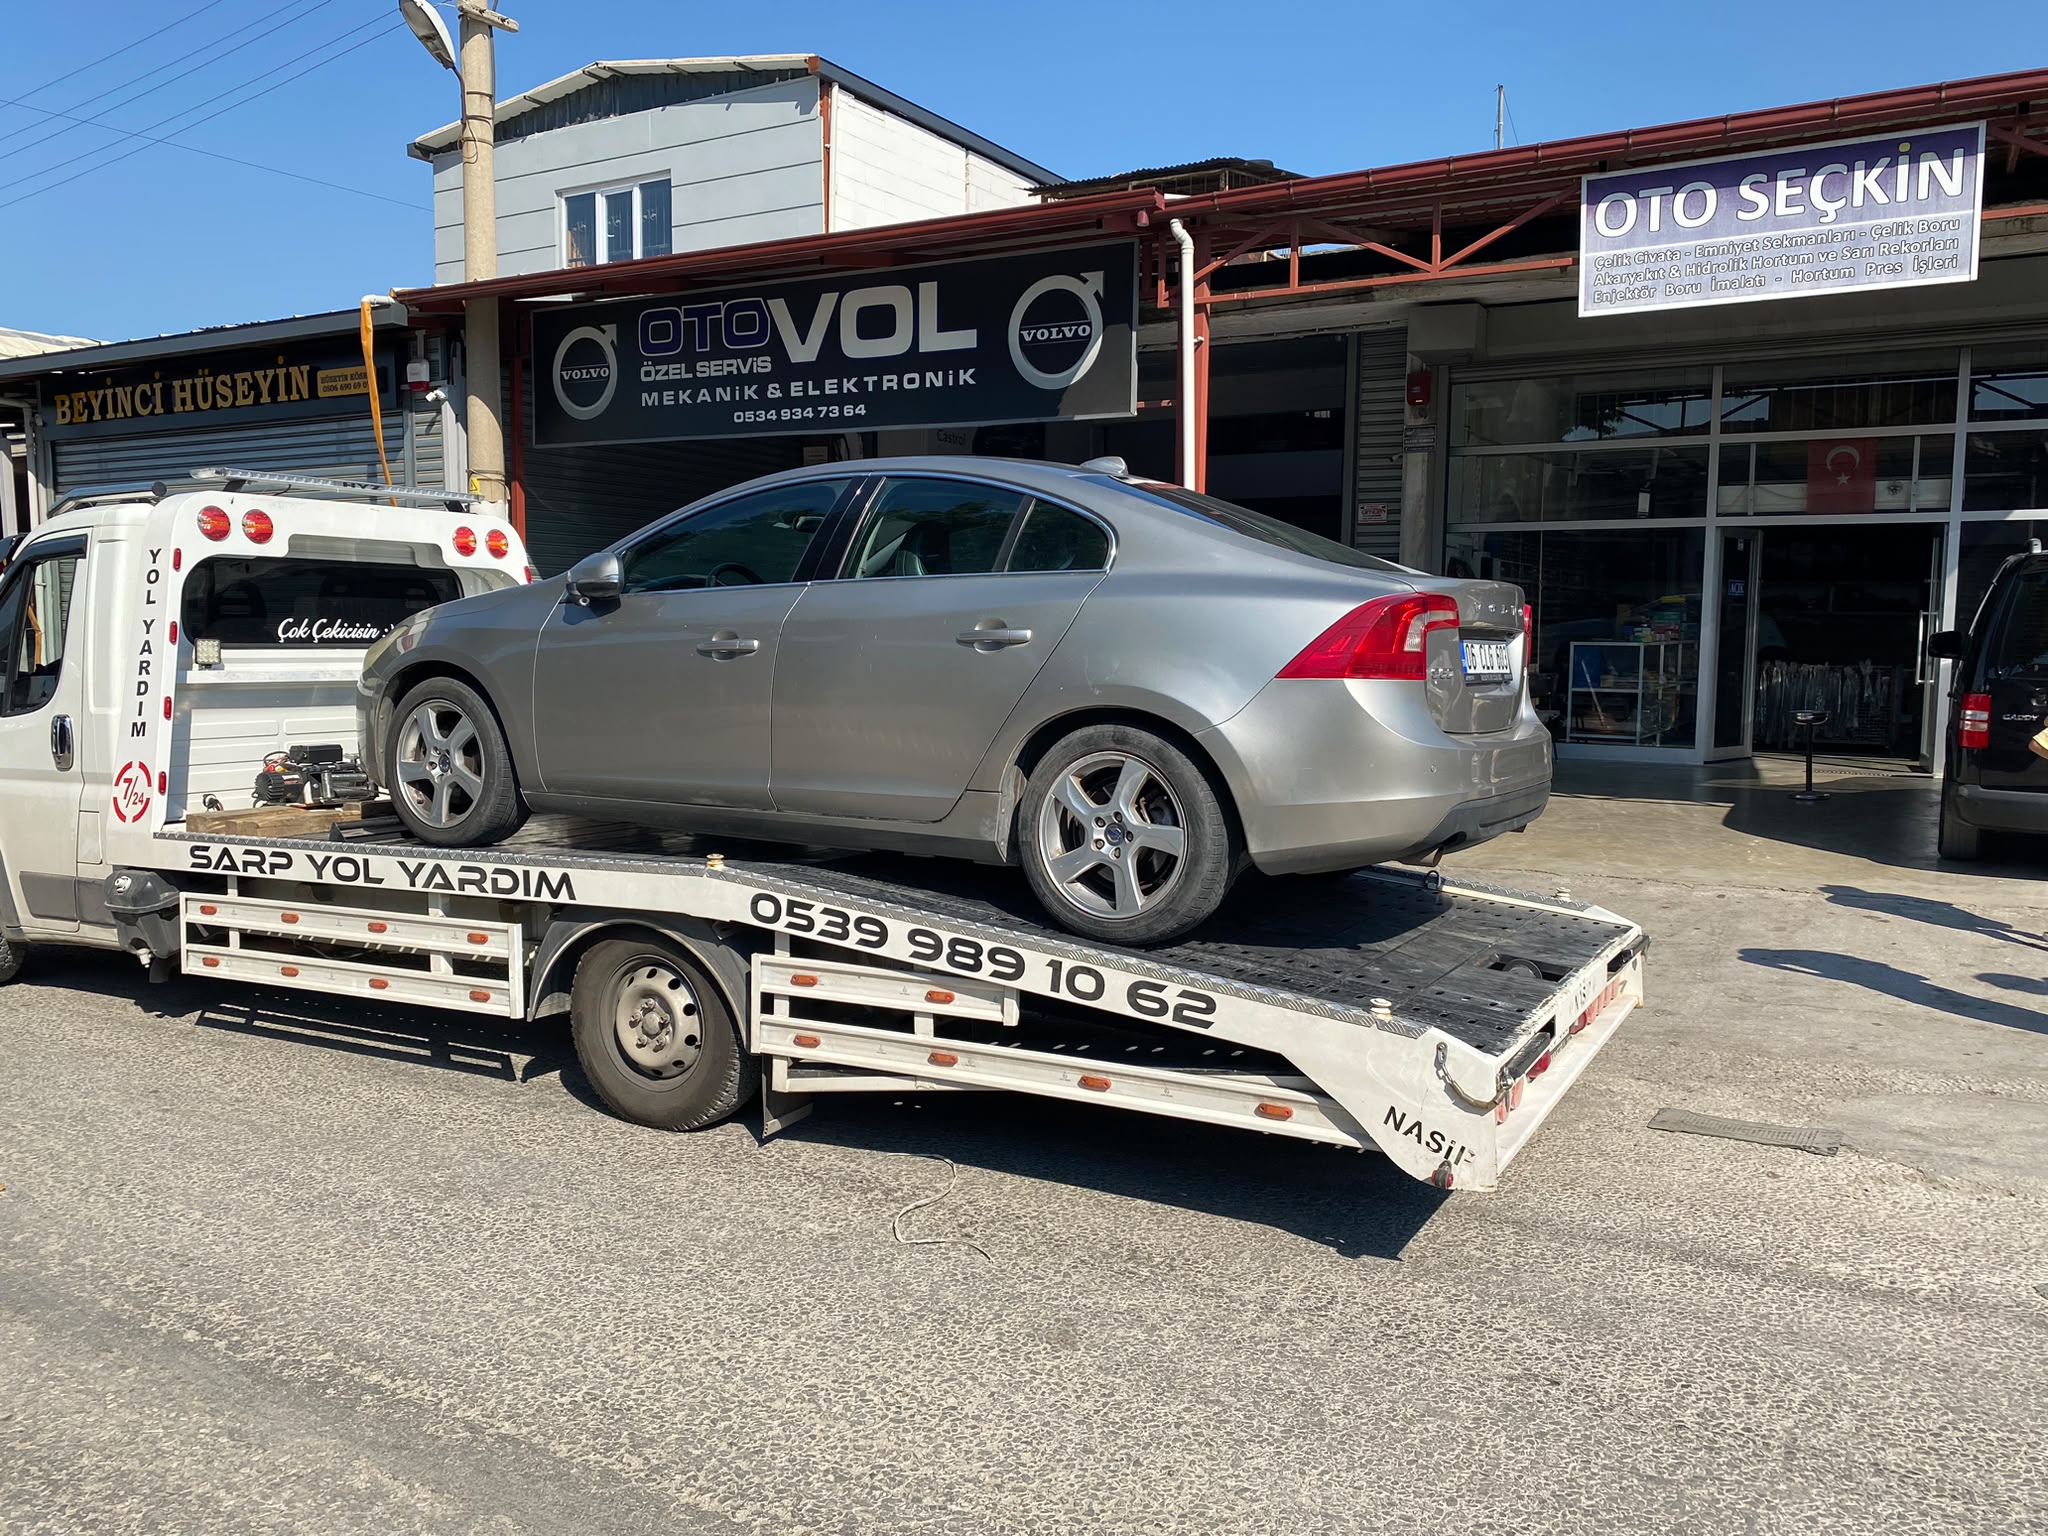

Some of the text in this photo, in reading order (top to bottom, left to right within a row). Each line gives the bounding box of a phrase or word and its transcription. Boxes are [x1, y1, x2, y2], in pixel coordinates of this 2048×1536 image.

[1594, 142, 1965, 238] OTO SEÇKİN
[1594, 253, 1631, 272] Çelik
[1634, 250, 1681, 264] Civata
[1695, 239, 1759, 258] Emniyet
[1762, 230, 1856, 250] Sekmanları
[1870, 217, 1914, 240] Çelik
[1918, 218, 1961, 233] Boru
[1593, 286, 1657, 304] Enjektör
[1665, 282, 1702, 297] Boru
[1710, 275, 1766, 292] İmalatı
[1791, 266, 1856, 284] Hortum
[1865, 262, 1904, 277] Pres
[1912, 254, 1959, 274] İşleri
[1594, 237, 1959, 287] Akaryakıt & Hidrolik Hortum ve Sarı Rekorları
[1020, 324, 1092, 343] VOLVO
[353, 381, 362, 390] 69
[560, 366, 610, 381] VOLVO
[640, 360, 693, 382] ÖZEL
[55, 355, 311, 425] BEYİNCİ HÜSEYİN
[767, 383, 783, 399] &
[733, 403, 867, 423] 0534 934 73 64
[145, 548, 162, 605] YOL
[277, 617, 310, 643] Çok
[311, 618, 380, 643] Çekicisin
[1465, 643, 1477, 670] 06
[131, 618, 156, 738] YARDIM
[2002, 713, 2040, 722] CADDY
[123, 775, 145, 809] 7/24
[189, 844, 577, 900] SARP YOL YARDIM
[750, 892, 1218, 1030] 0539 989 10 62
